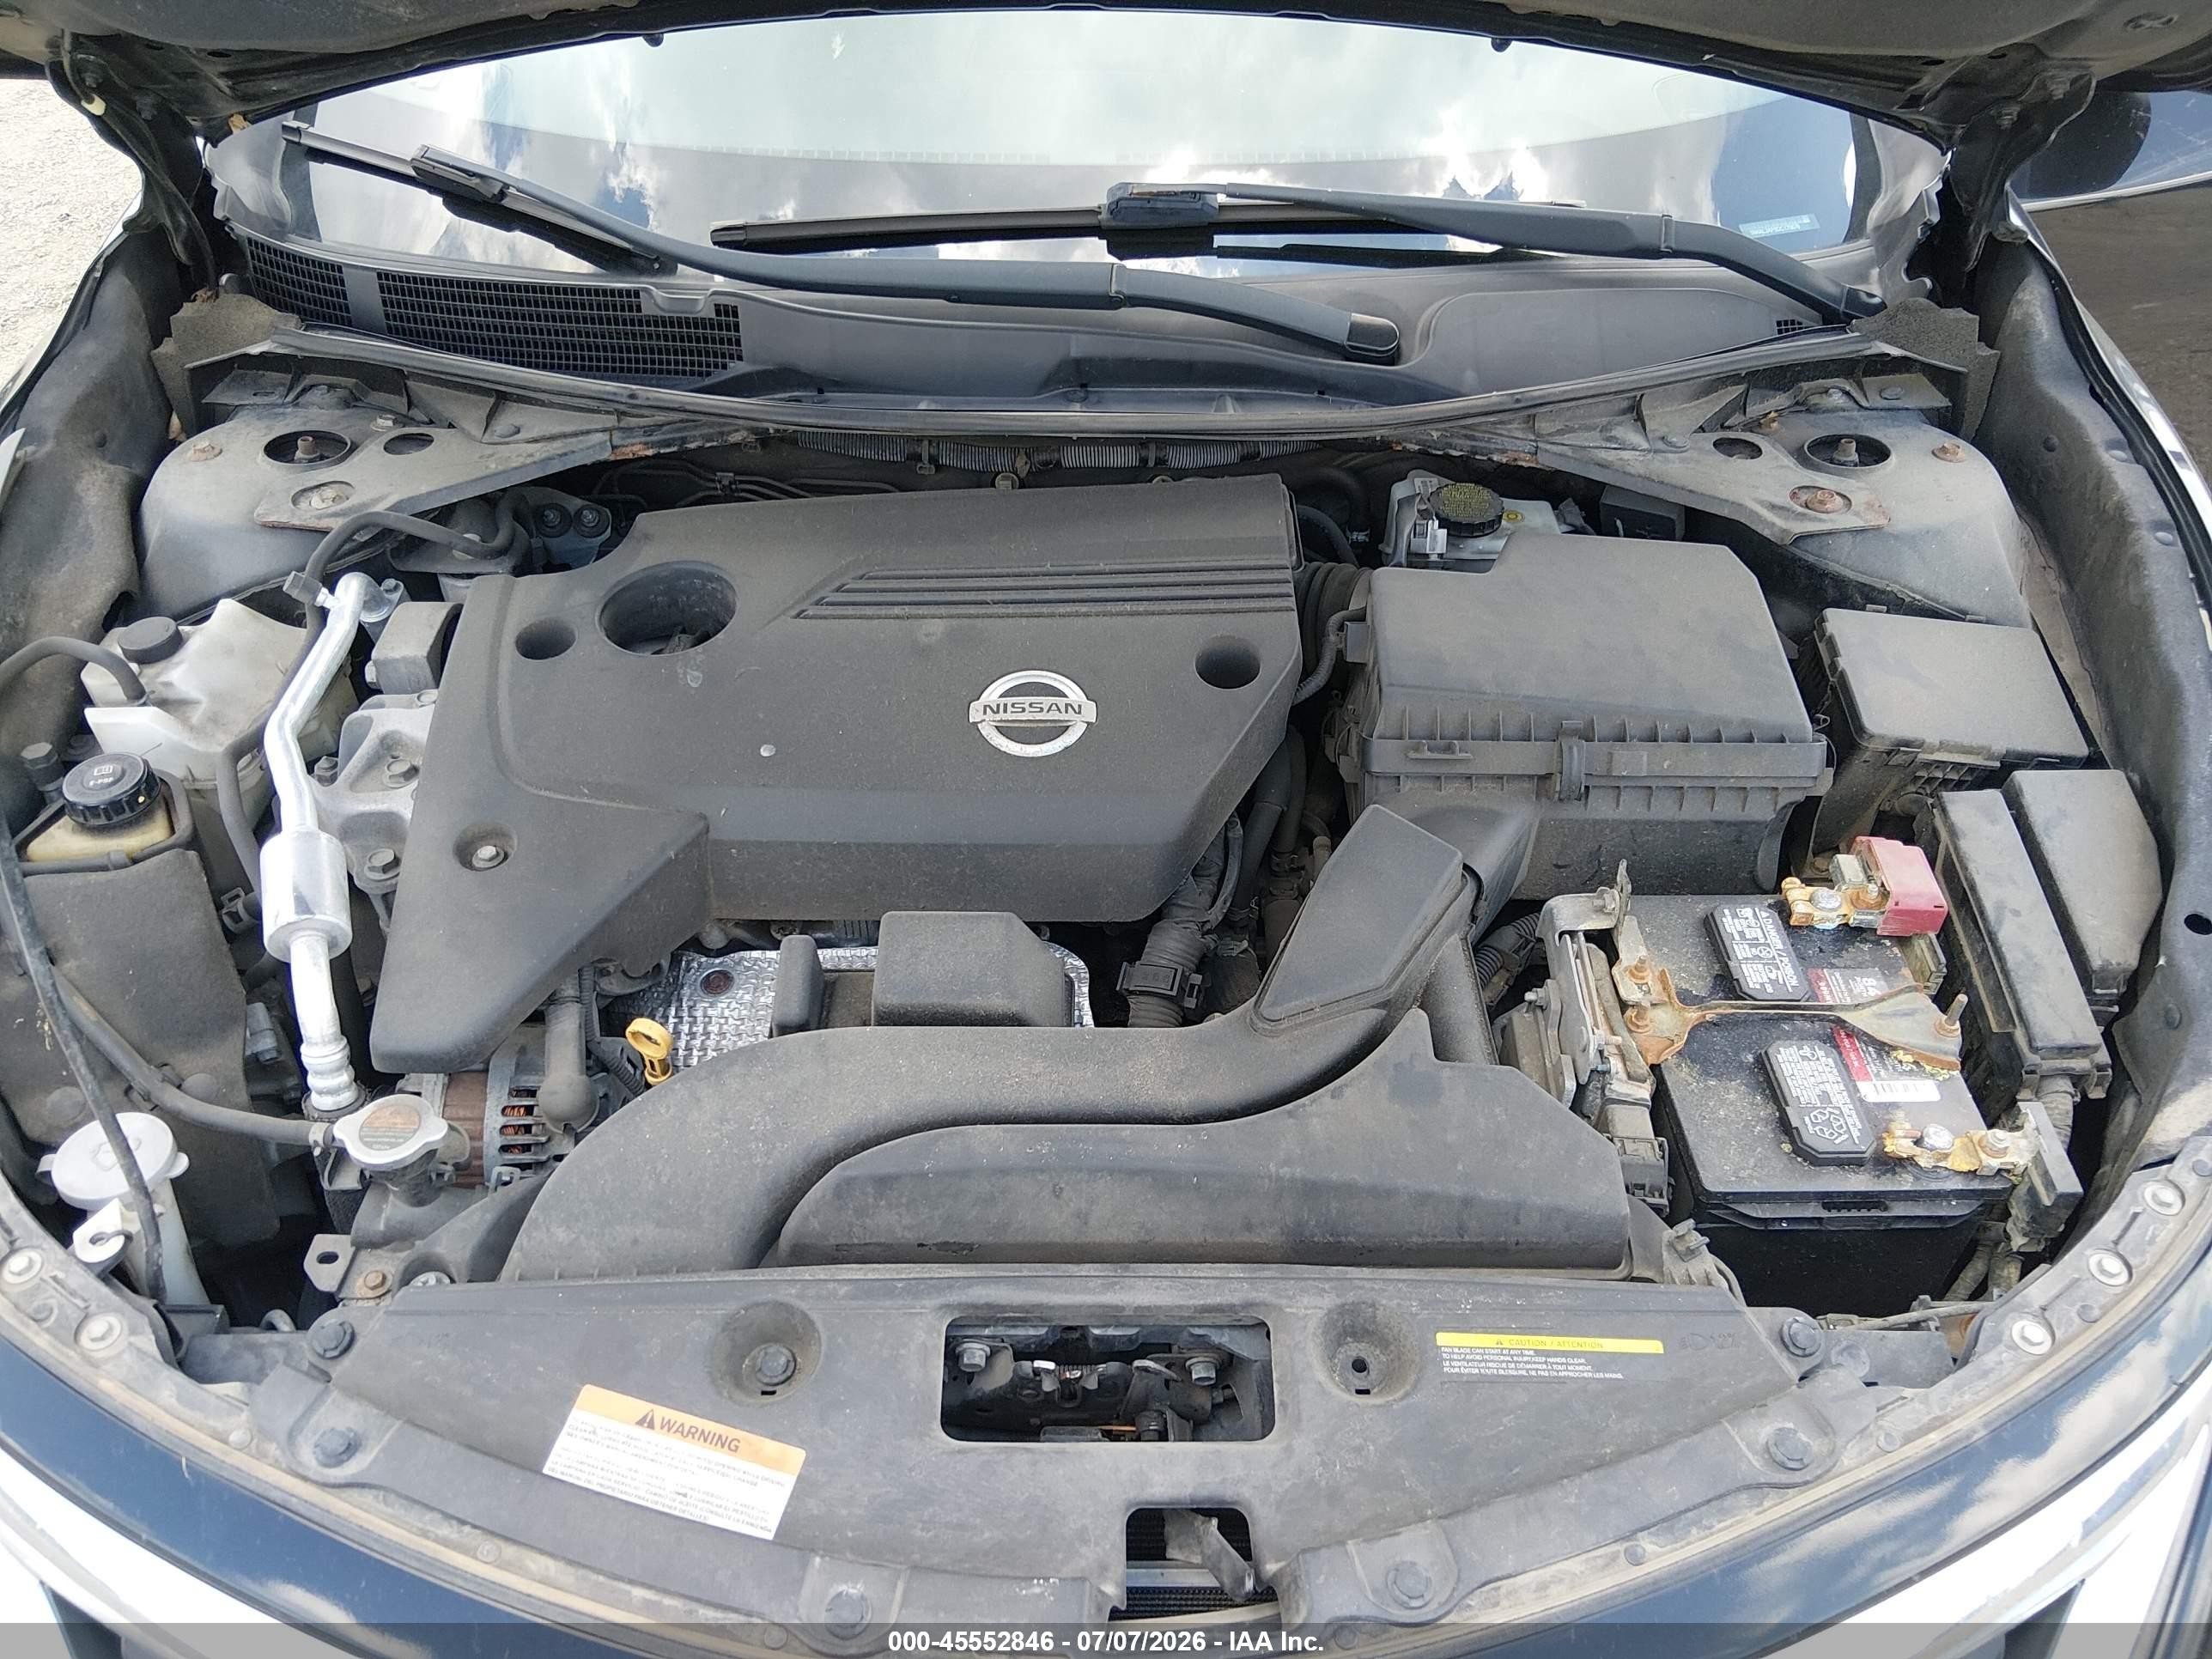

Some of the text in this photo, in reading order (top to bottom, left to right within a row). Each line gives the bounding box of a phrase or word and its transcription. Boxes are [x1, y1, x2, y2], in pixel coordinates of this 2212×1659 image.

[982, 702, 1082, 716] NISSAN
[1763, 919, 1784, 950] DANGER
[1778, 957, 1800, 987] POISON
[660, 1417, 742, 1455] WARNING
